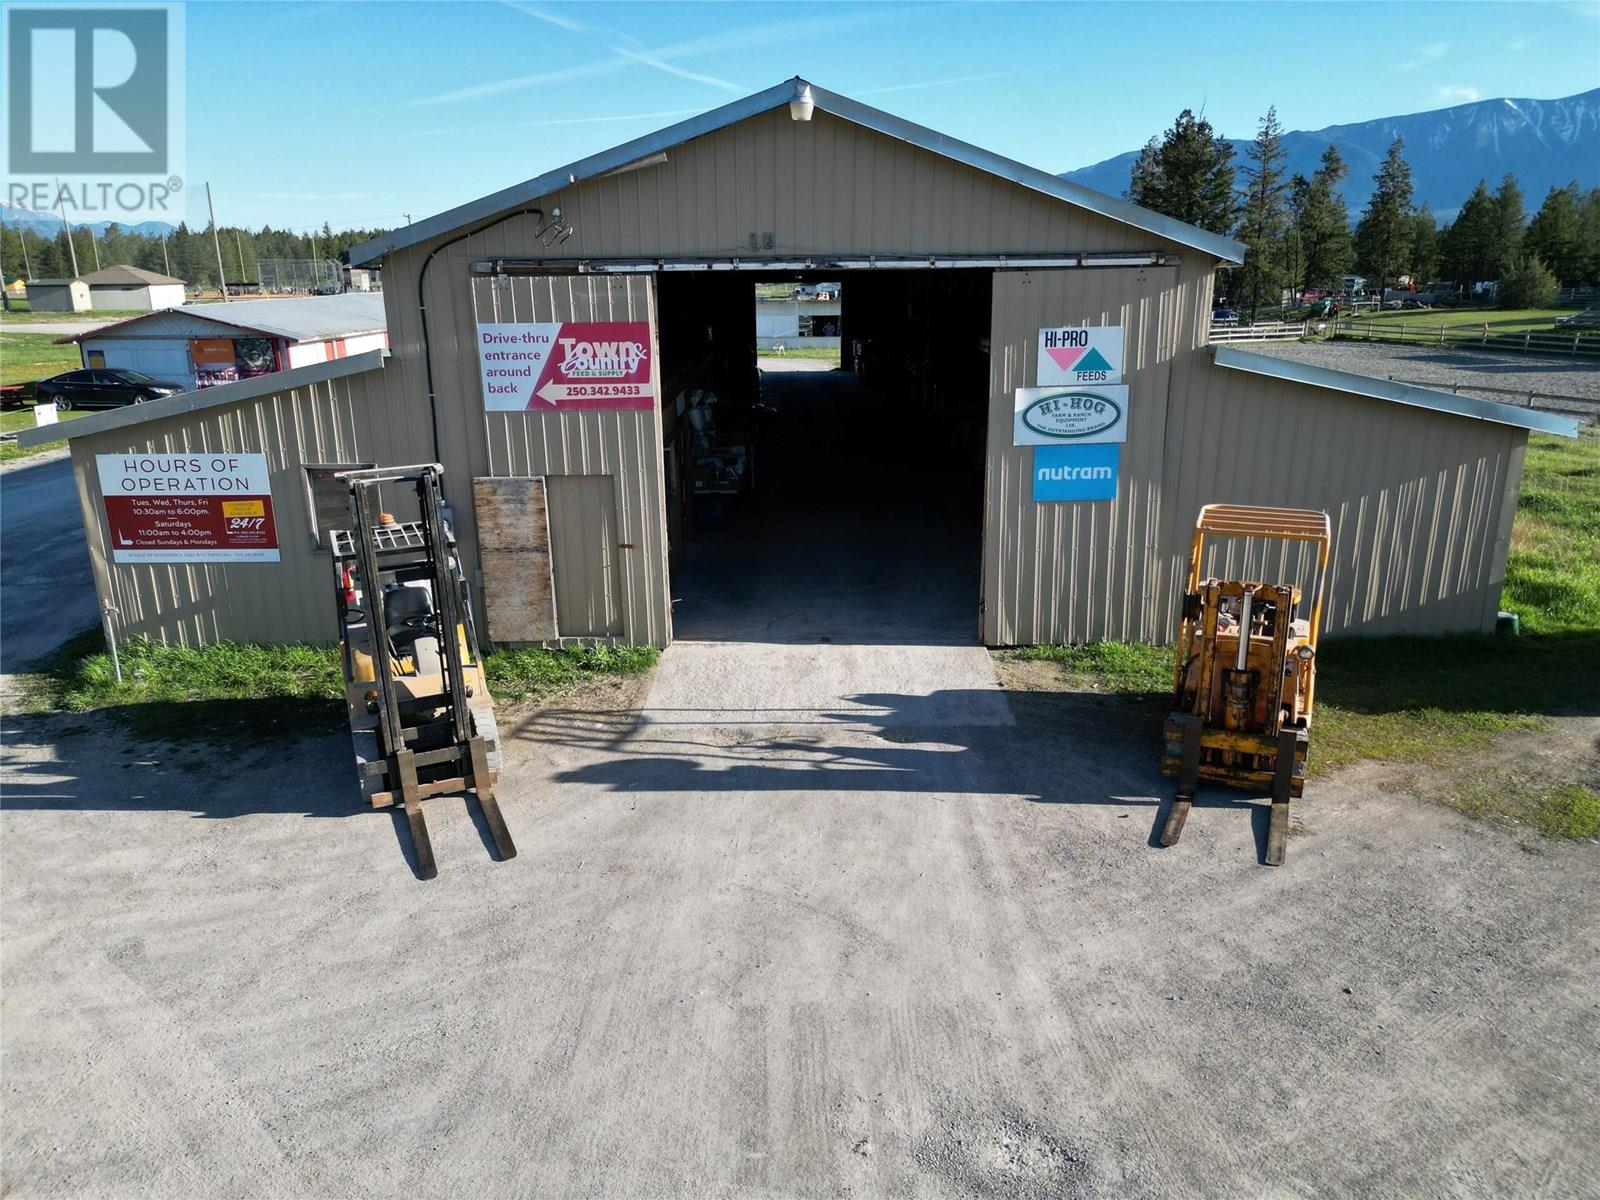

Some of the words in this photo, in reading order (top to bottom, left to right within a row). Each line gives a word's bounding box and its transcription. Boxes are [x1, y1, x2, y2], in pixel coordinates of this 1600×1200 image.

[482, 332, 549, 344] Drive-thru
[1044, 330, 1089, 348] HI-PRO
[558, 338, 637, 361] Town
[484, 351, 541, 361] entrance
[557, 349, 641, 374] Country
[486, 366, 531, 377] around
[1076, 371, 1107, 382] FEEDS
[487, 382, 518, 394] back
[566, 385, 641, 396] 250.342.9433
[124, 459, 202, 473] HOURS
[211, 458, 239, 473] OF
[1038, 465, 1112, 481] nutram
[121, 477, 250, 492] OPERATION
[152, 499, 172, 507] Wed,
[154, 520, 192, 529] Saturdays
[230, 517, 265, 530] 24/7
[180, 529, 212, 537] 4:00pm
[190, 538, 218, 546] Mondays
